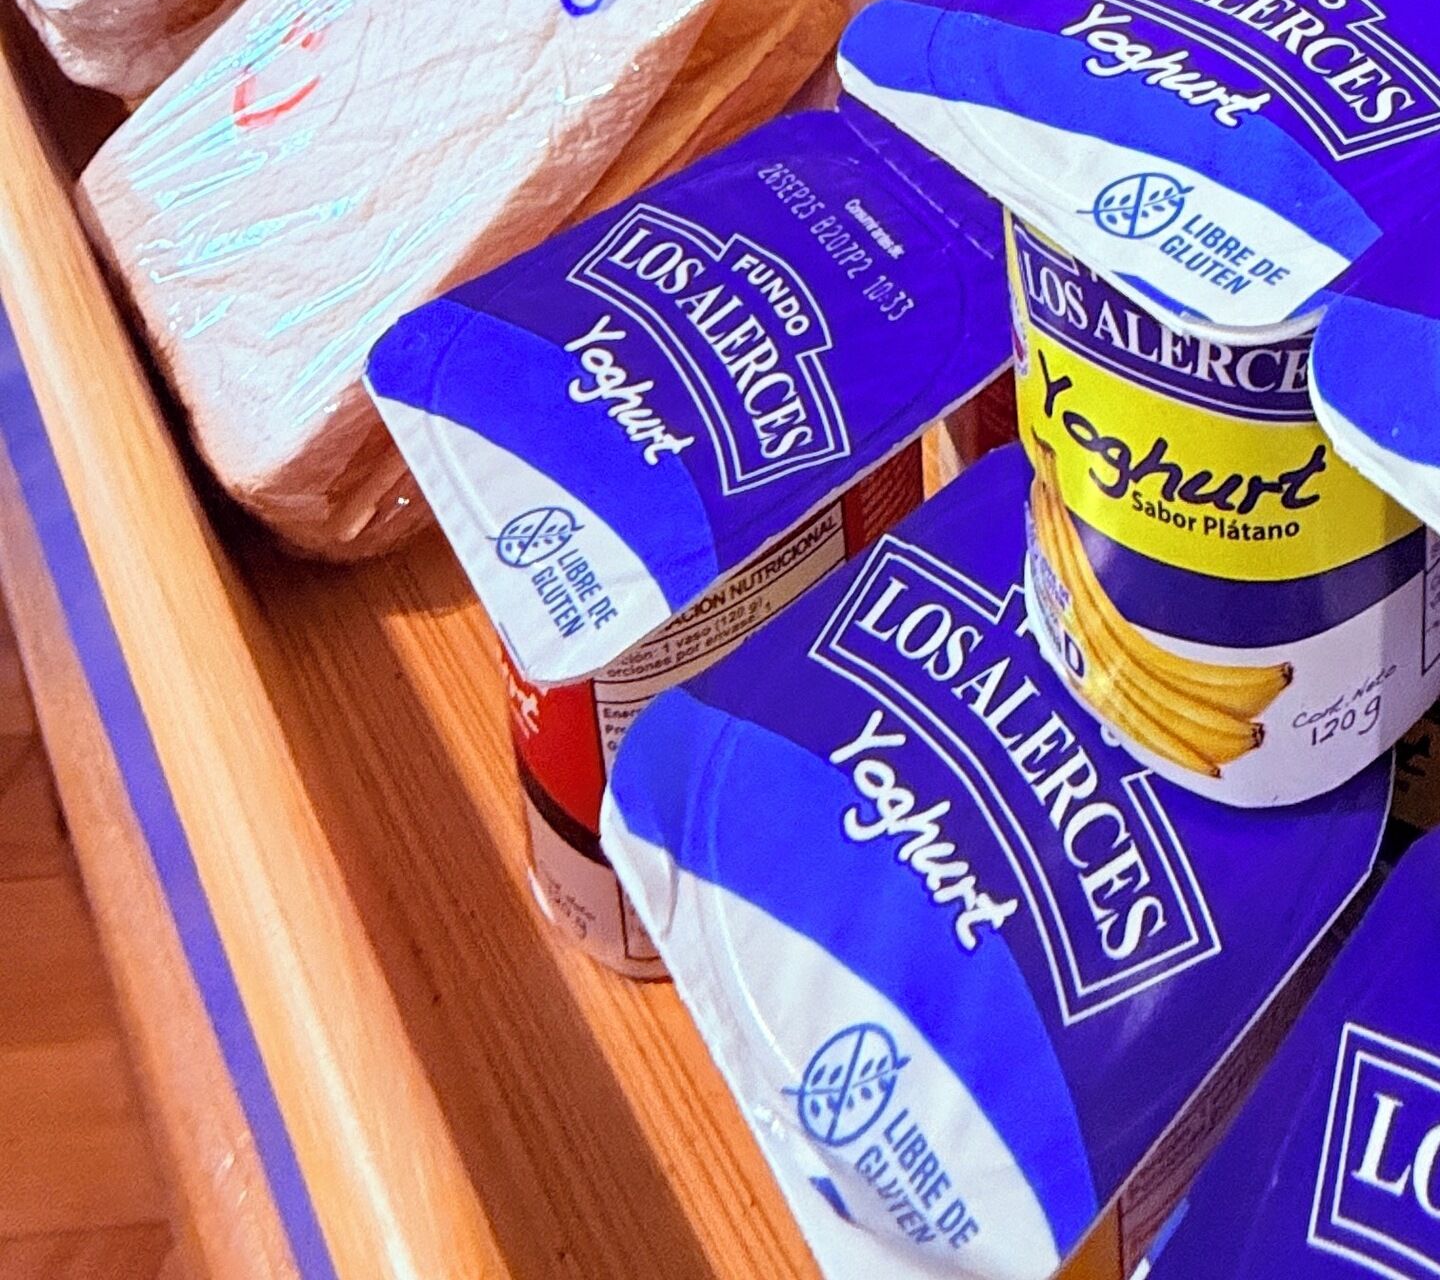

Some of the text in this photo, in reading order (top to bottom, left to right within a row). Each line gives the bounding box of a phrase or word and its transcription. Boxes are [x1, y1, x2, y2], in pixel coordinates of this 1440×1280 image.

[1060, 2, 1272, 129] Yoghurt
[1022, 249, 1089, 331] LOS
[1158, 235, 1252, 295] GLUTEN
[1182, 214, 1291, 287] LIBRE DE
[731, 253, 811, 337] FUNDO
[607, 223, 814, 460] LOS ALERCES
[564, 314, 695, 466] Yoghurt
[1037, 347, 1327, 516] Yoghurt
[729, 515, 838, 601] NUTRICIONAL
[1131, 489, 1301, 542] Sabor Plátano
[531, 565, 586, 639] GLUTEN
[557, 548, 619, 630] LIBRE DE
[606, 655, 673, 679] orciones
[855, 576, 1168, 962] LOS ALERCES
[829, 709, 1019, 951] Yoghurt
[853, 1145, 937, 1245] GLUTEN
[882, 1107, 980, 1250] LIBRE DE
